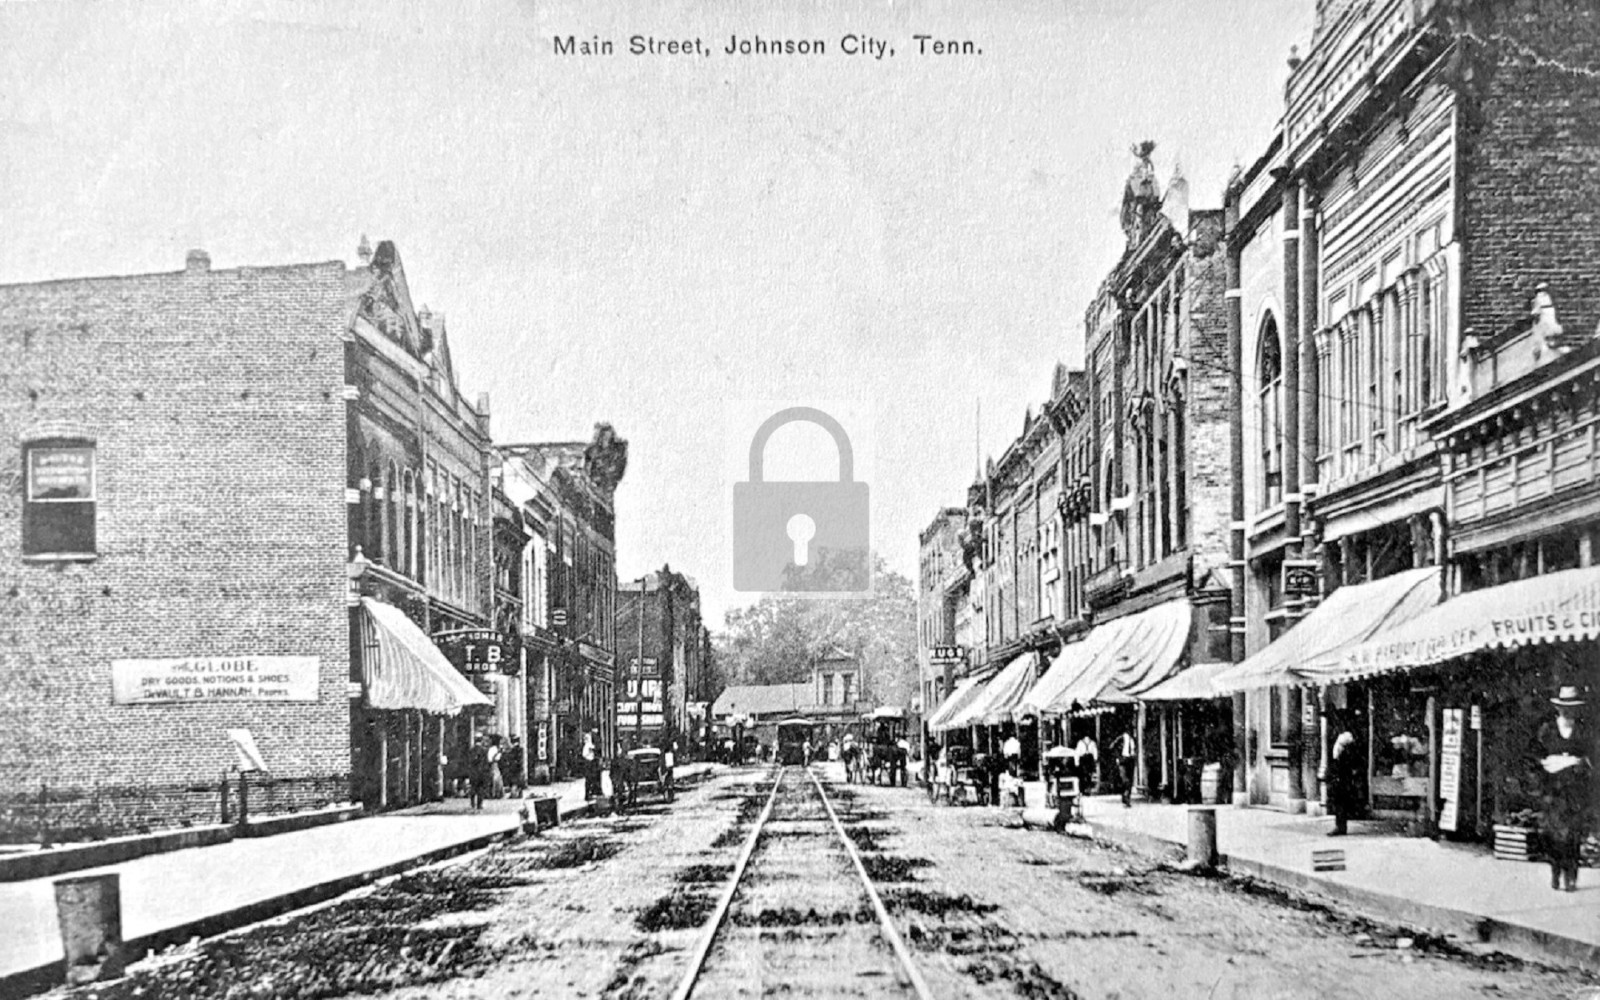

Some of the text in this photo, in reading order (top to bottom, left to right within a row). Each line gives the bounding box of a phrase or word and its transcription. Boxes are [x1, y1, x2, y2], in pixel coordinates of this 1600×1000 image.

[1491, 614, 1556, 637] FRUITS
[193, 660, 258, 673] GLOBE
[141, 677, 161, 687] DRY
[203, 675, 245, 684] NOTIONS
